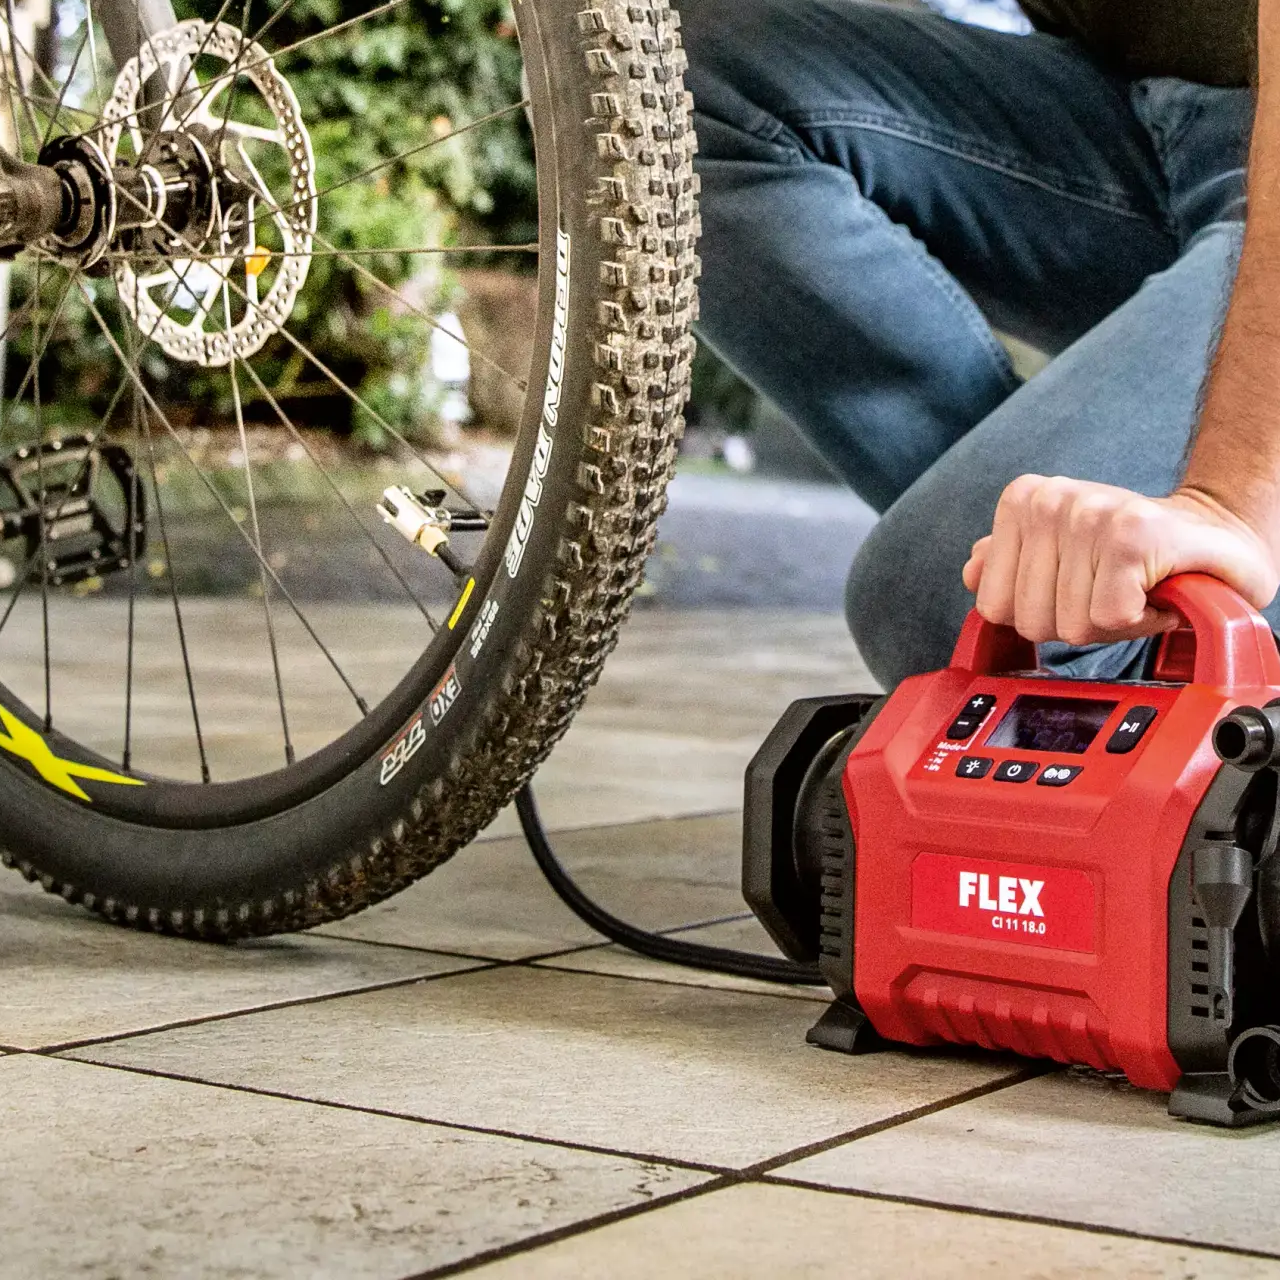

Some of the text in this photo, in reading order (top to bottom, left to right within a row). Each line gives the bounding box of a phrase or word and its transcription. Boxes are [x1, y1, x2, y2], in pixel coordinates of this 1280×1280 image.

[431, 677, 461, 722] EXO
[959, 871, 1045, 917] FLEX
[992, 916, 1046, 935] CI 11 18.0
